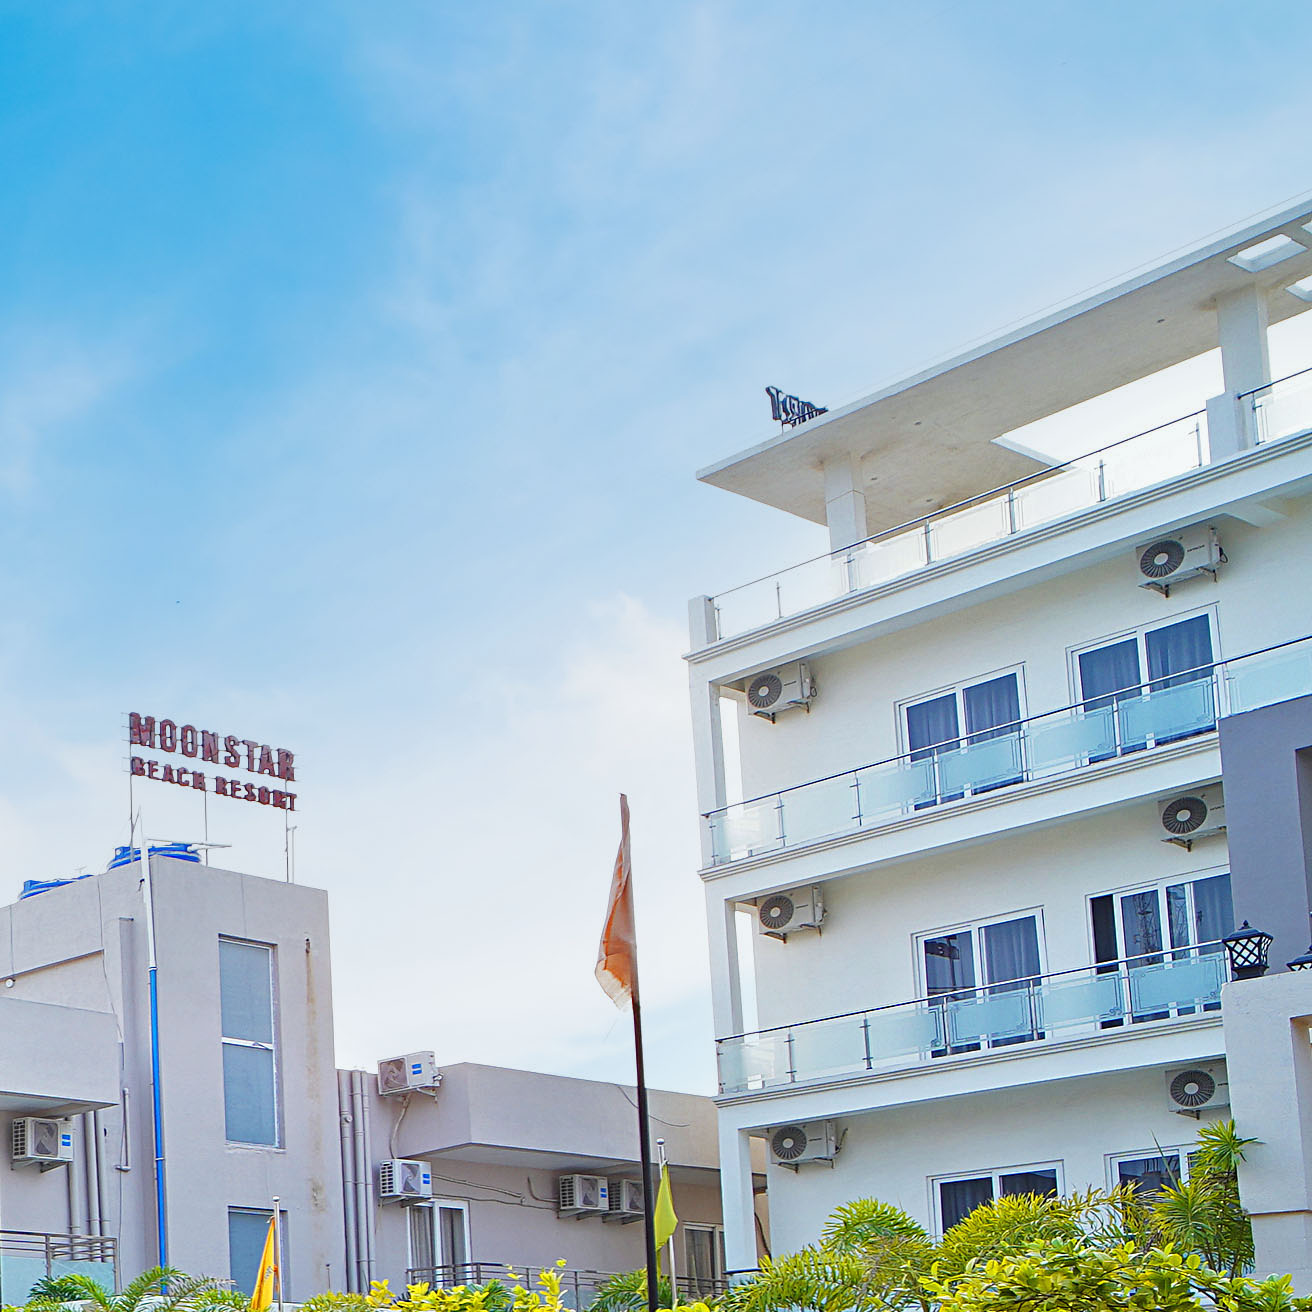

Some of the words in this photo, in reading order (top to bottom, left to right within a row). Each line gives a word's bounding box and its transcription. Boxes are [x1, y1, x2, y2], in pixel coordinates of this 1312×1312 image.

[129, 712, 295, 781] MOONSTAR
[130, 756, 206, 791] BEACH
[215, 776, 298, 811] RESORT
